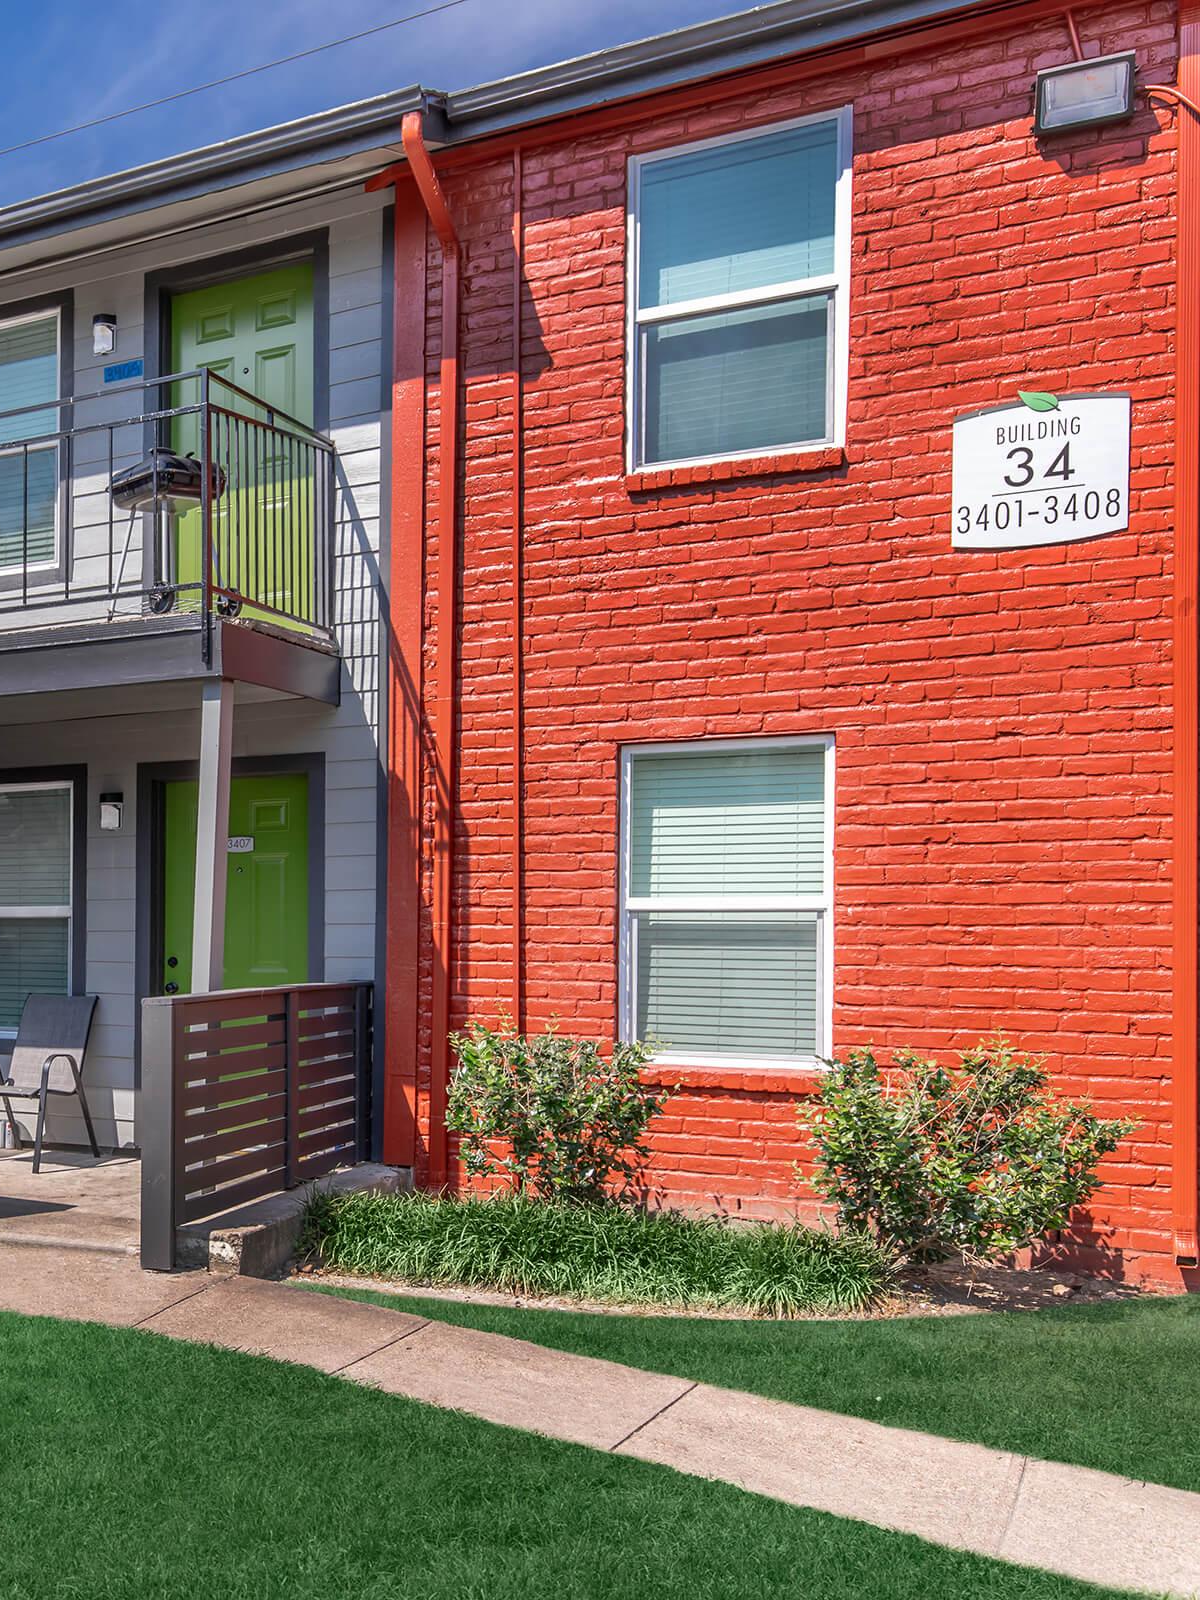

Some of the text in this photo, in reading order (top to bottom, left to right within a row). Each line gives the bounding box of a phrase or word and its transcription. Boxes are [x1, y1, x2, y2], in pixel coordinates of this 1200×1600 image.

[996, 416, 1081, 445] BUILDING
[1003, 441, 1076, 487] 34
[957, 488, 1121, 534] 3401-3408
[227, 838, 251, 849] 3407
